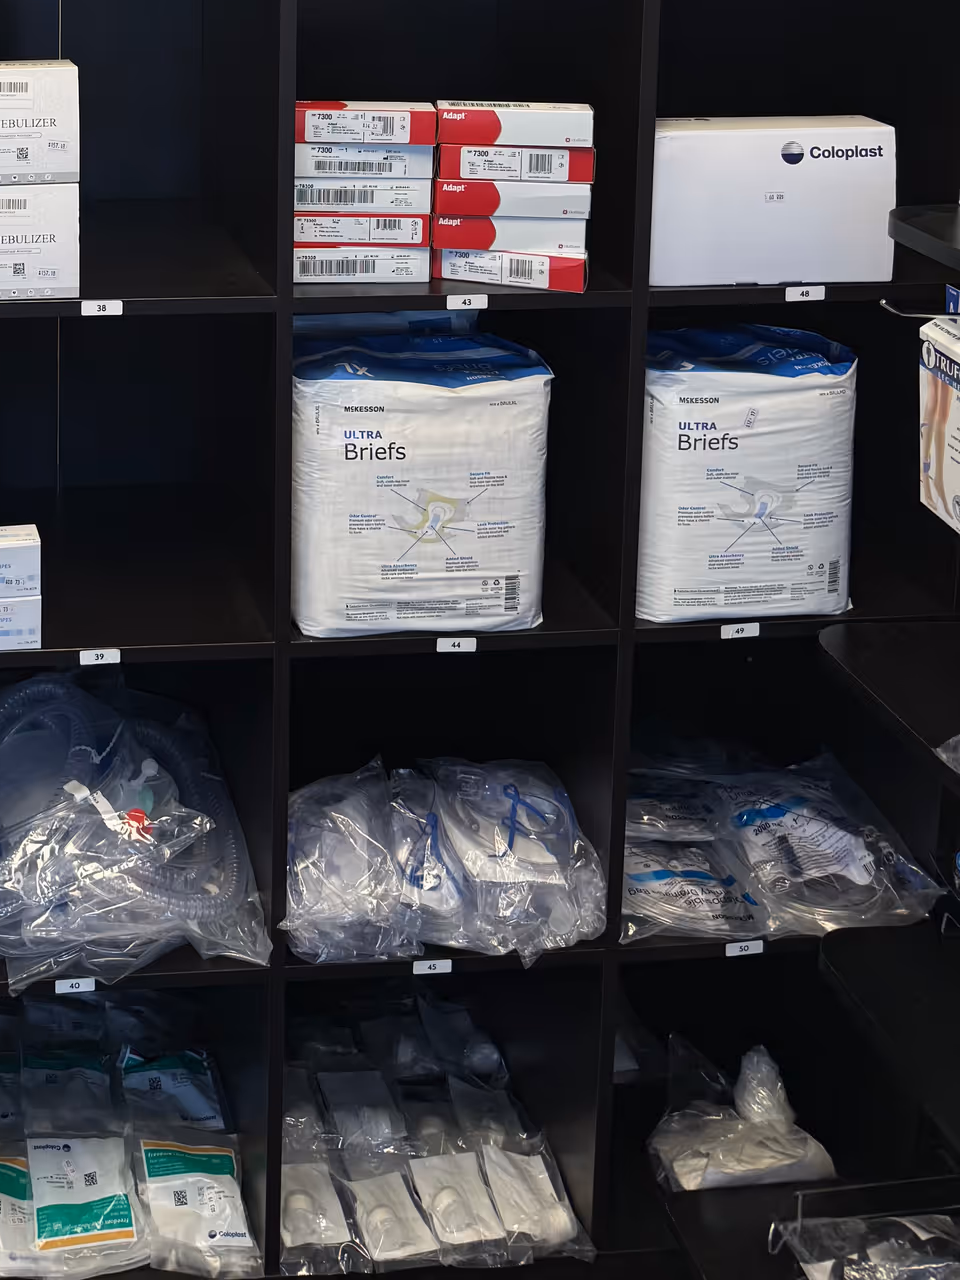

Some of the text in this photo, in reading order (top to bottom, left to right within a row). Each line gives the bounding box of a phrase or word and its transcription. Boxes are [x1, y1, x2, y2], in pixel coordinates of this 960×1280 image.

[443, 112, 465, 120] Adapt
[810, 145, 883, 160] Coloplast
[442, 184, 465, 192] Adapt
[438, 216, 461, 226] Adapt
[454, 251, 470, 259] 7300
[97, 304, 107, 312] 38
[935, 353, 960, 380] TRUF
[679, 422, 717, 430] ULTRA
[344, 430, 382, 439] ULTRA
[678, 433, 738, 451] Briefs
[345, 442, 406, 460] Briefs
[735, 627, 745, 635] 49
[451, 642, 461, 650] 44
[95, 653, 104, 661] 39
[739, 944, 750, 952] 50
[427, 963, 437, 971] 45
[69, 982, 80, 990] 40
[216, 1228, 249, 1239] Coloplast
